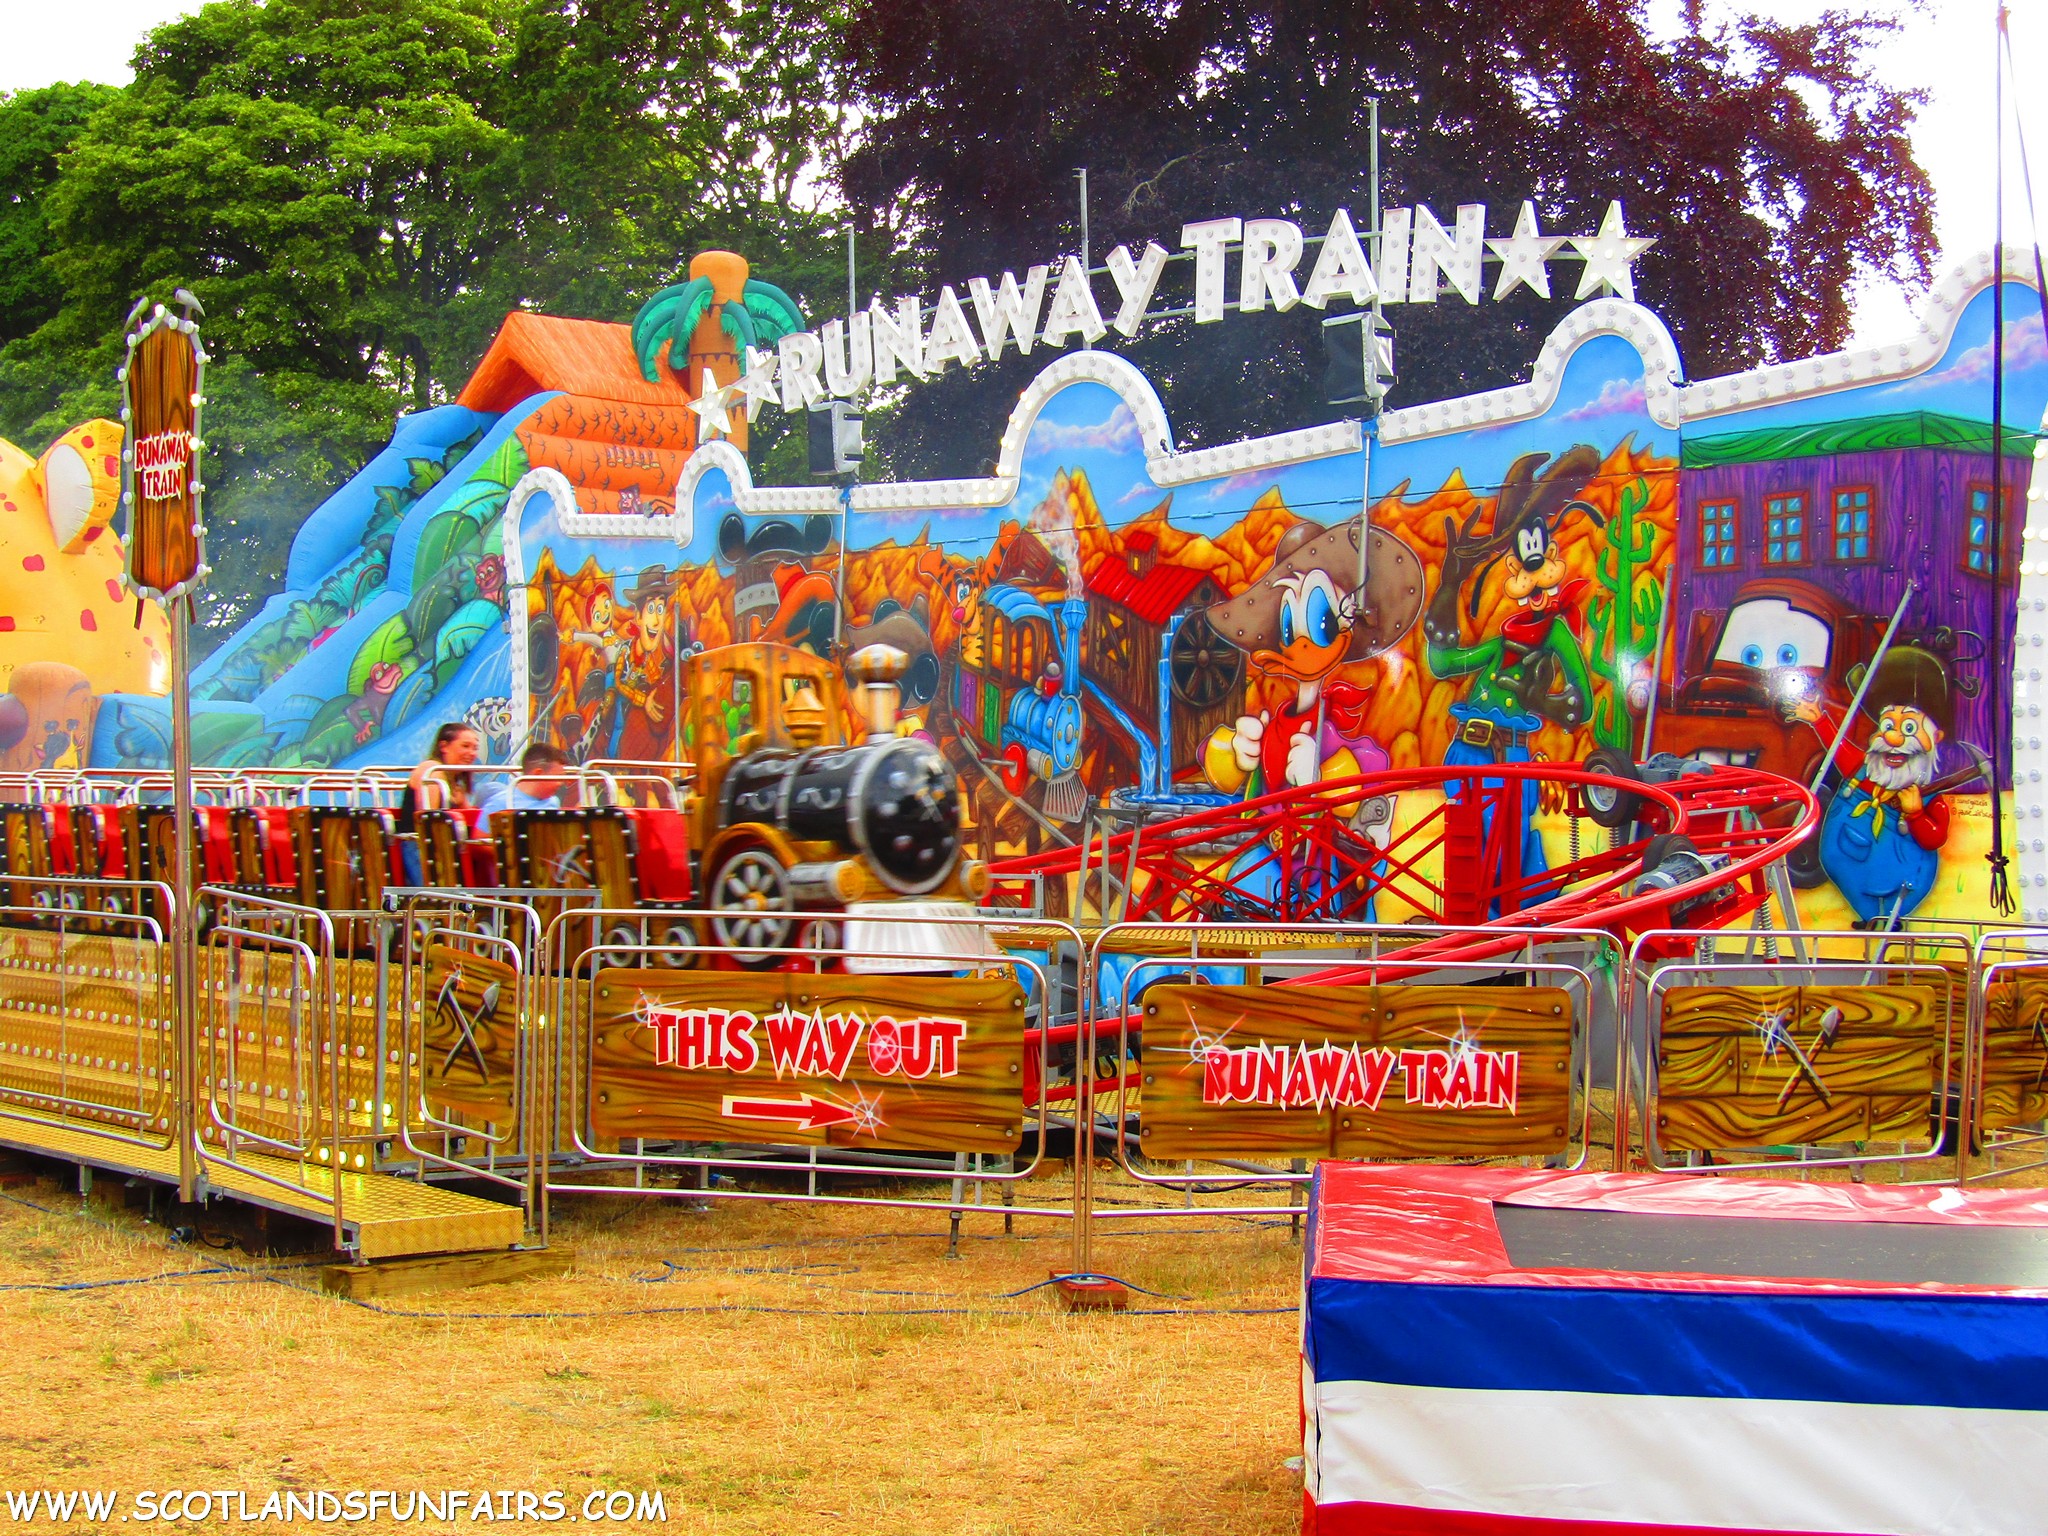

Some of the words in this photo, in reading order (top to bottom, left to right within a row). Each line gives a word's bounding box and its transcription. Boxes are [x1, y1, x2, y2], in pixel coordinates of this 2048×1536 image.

[778, 243, 1168, 413] RUNAWAY
[1181, 203, 1485, 324] TRAIN
[134, 429, 193, 472] RUNAWAY
[144, 468, 182, 501] TRAIN
[648, 1007, 759, 1073] THIS
[764, 1003, 865, 1082] WAY
[868, 1016, 967, 1079] OUT
[1203, 1039, 1396, 1114] RUNAWAY
[1398, 1049, 1518, 1116] TRAIN
